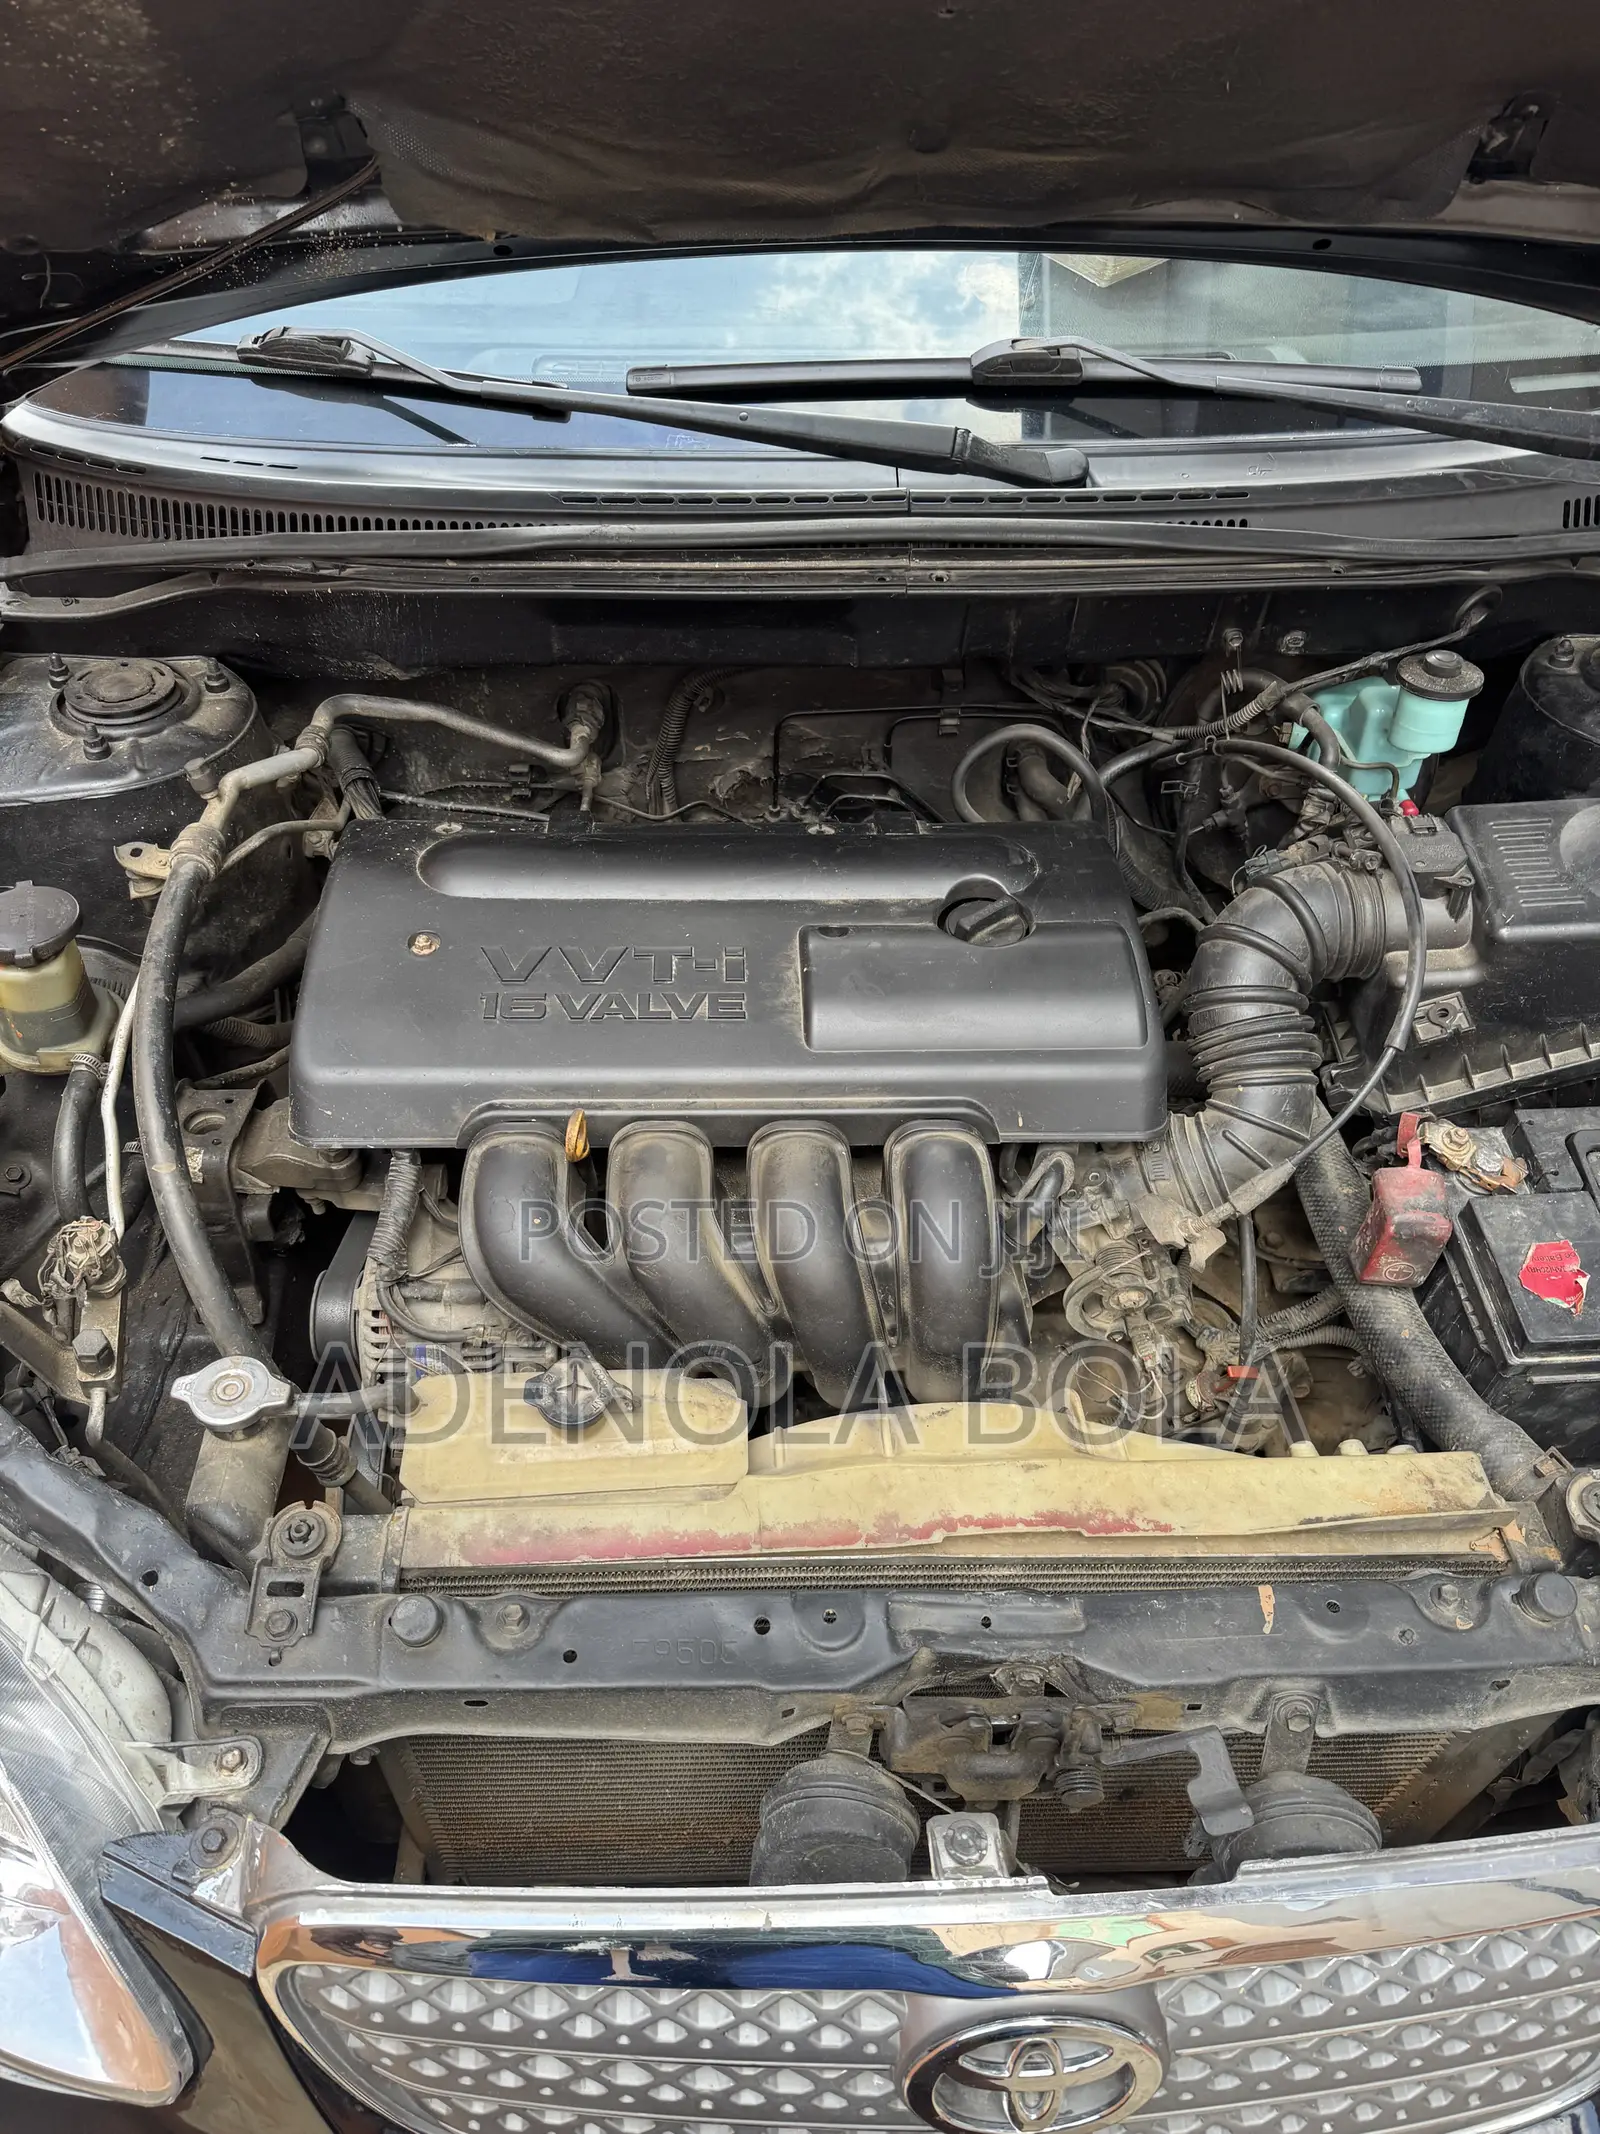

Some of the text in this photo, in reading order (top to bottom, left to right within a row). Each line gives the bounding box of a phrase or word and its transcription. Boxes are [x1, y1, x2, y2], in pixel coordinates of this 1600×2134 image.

[480, 946, 748, 984] VVT-i
[480, 992, 747, 1020] 16 VALVE
